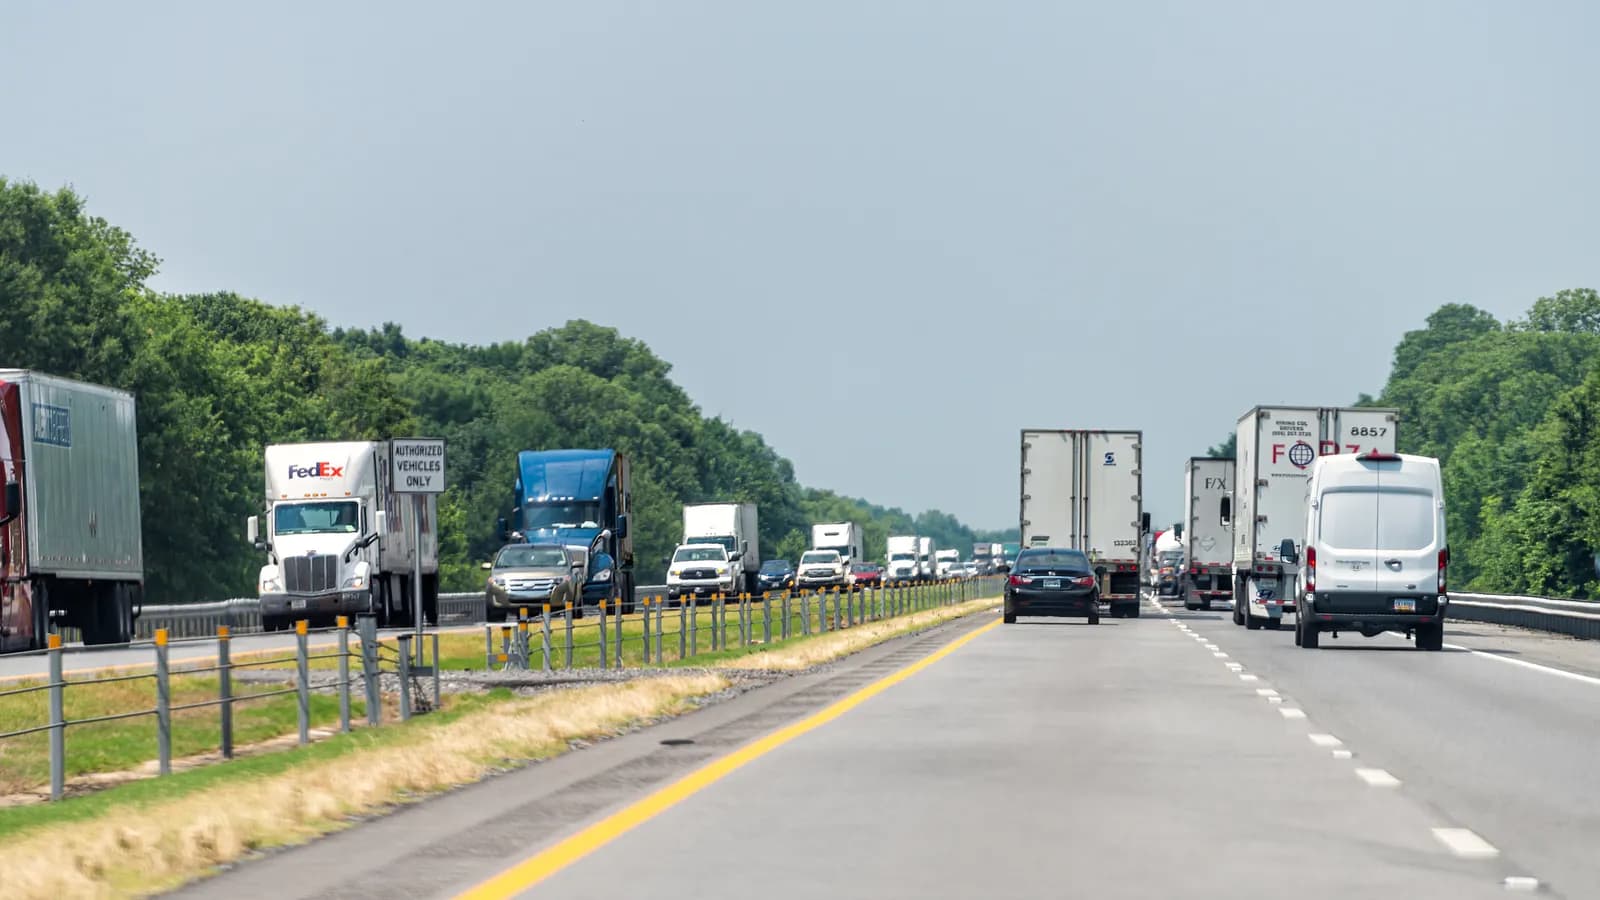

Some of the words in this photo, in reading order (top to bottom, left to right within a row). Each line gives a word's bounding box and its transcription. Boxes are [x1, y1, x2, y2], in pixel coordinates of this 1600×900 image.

[1350, 426, 1387, 437] 8857
[395, 445, 442, 456] AUTHORIZED
[288, 461, 344, 480] FedEx
[397, 460, 440, 472] VEHICLES
[406, 475, 431, 487] ONLY
